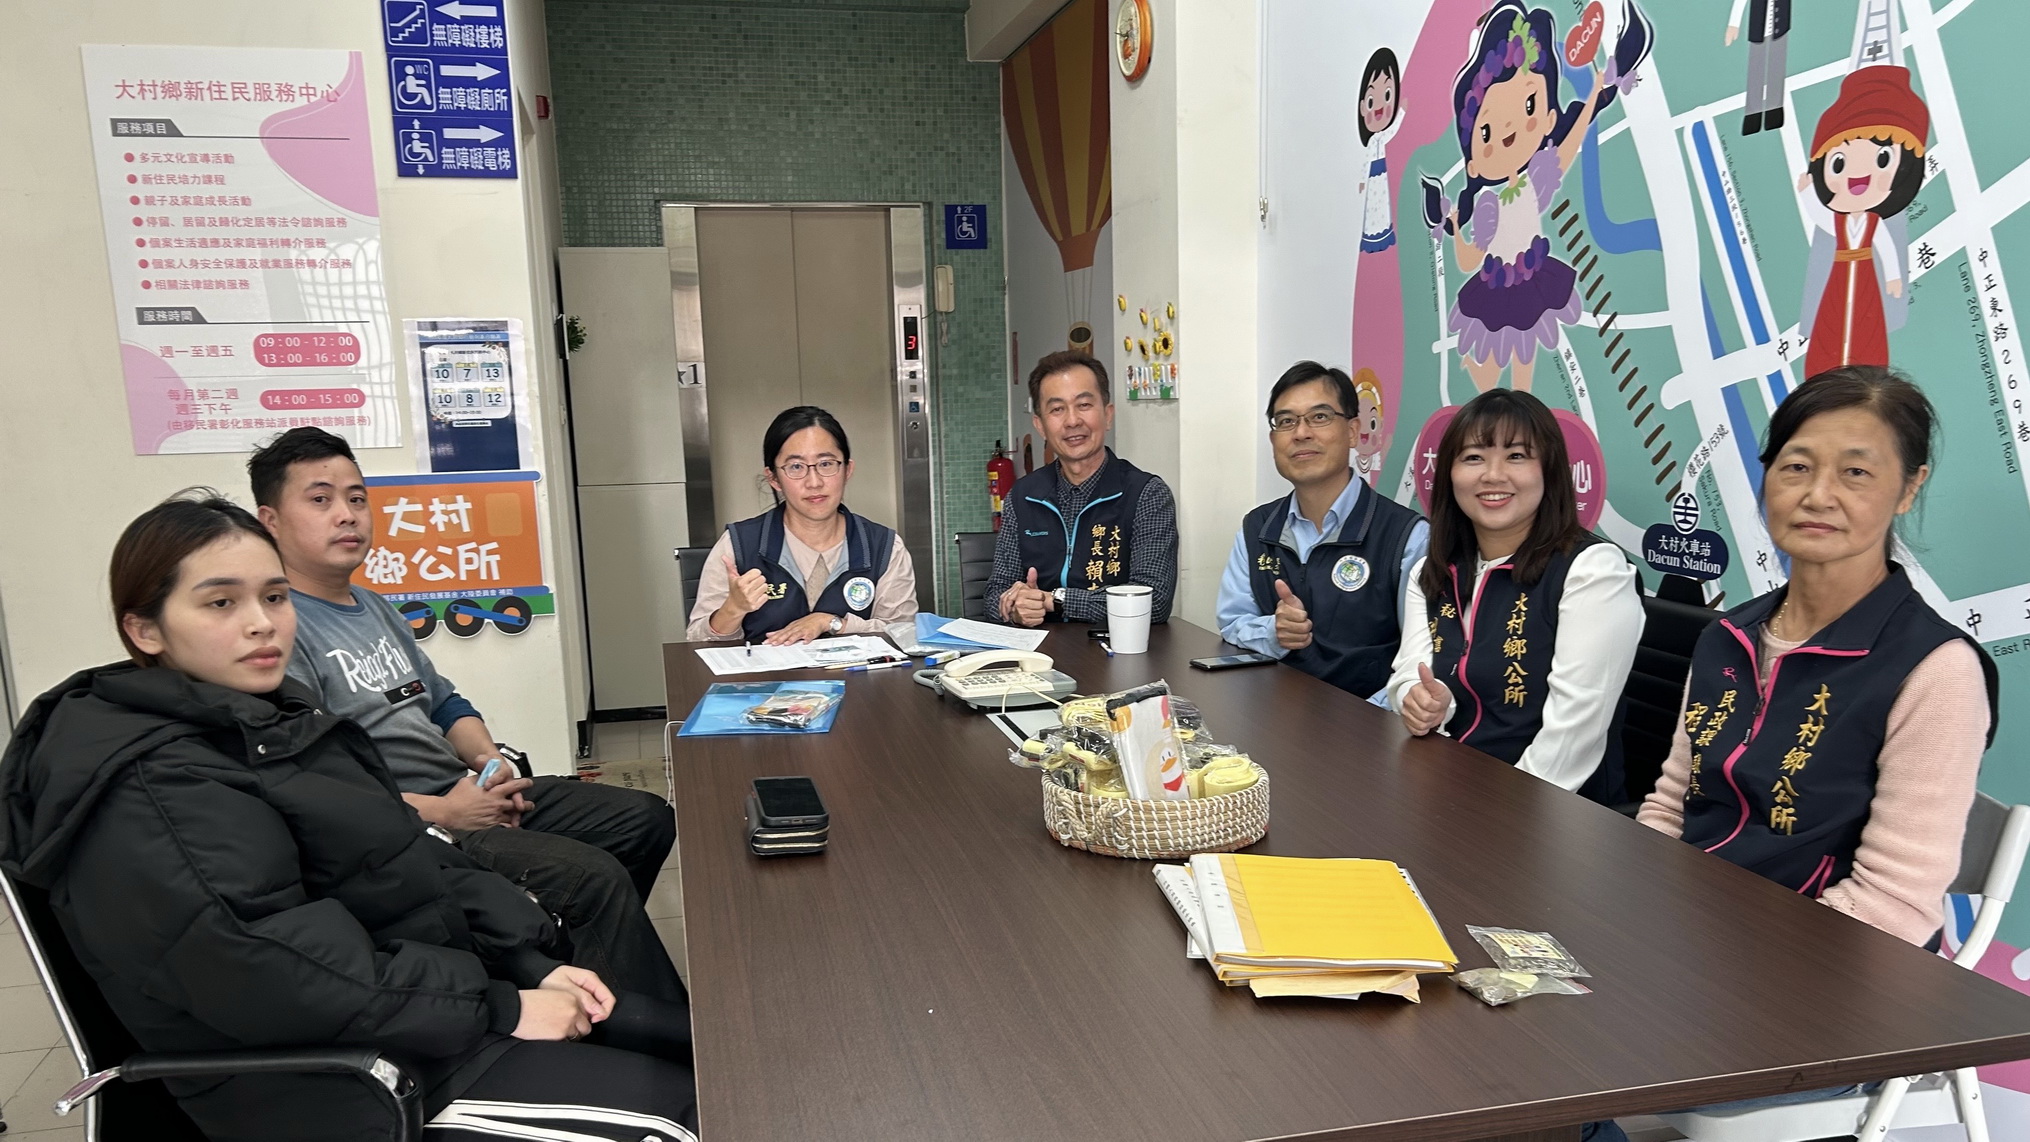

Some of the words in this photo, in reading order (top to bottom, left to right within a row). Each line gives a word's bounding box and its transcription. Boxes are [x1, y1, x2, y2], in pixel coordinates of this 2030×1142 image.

[432, 23, 504, 48] 無障礙樓梯
[1568, 12, 1602, 62] DACUN
[414, 64, 429, 75] WC
[114, 79, 341, 104] 大村鄉新住民服務中心
[438, 87, 508, 111] 無障礙廁所
[116, 122, 167, 135] 服務項目
[139, 153, 235, 165] 多元文化宣導活動
[441, 147, 511, 171] 無障礙電梯
[141, 174, 226, 186] 新住民培力課程
[144, 195, 252, 207] 親子及家庭成長活動
[159, 345, 235, 358] 週一至週五
[907, 336, 918, 350] 3
[1978, 247, 2030, 443] 中正東路269巷
[435, 369, 450, 379] 10
[463, 369, 471, 378] 7
[486, 369, 500, 378] 13
[1957, 261, 1972, 294] Lane
[1967, 296, 1978, 329] 269,
[1975, 330, 2000, 407] Zhongzheng
[1994, 409, 2008, 438] East
[2003, 440, 2018, 475] Road
[167, 388, 239, 400] 每月第二週
[438, 394, 452, 404] 10
[466, 394, 474, 403] 8
[488, 393, 502, 403] 12
[175, 403, 232, 416] 週三下午
[382, 494, 472, 537] 大村
[1105, 524, 1122, 577] 大村鄉
[1658, 534, 1711, 558] 大村火車站
[364, 541, 501, 585] 鄉公所
[1647, 549, 1680, 568] Dacun
[1682, 554, 1722, 575] Station
[1502, 591, 1529, 708] 大村鄉公所
[1993, 642, 2020, 657] East
[1770, 683, 1832, 836] 大村鄉公所
